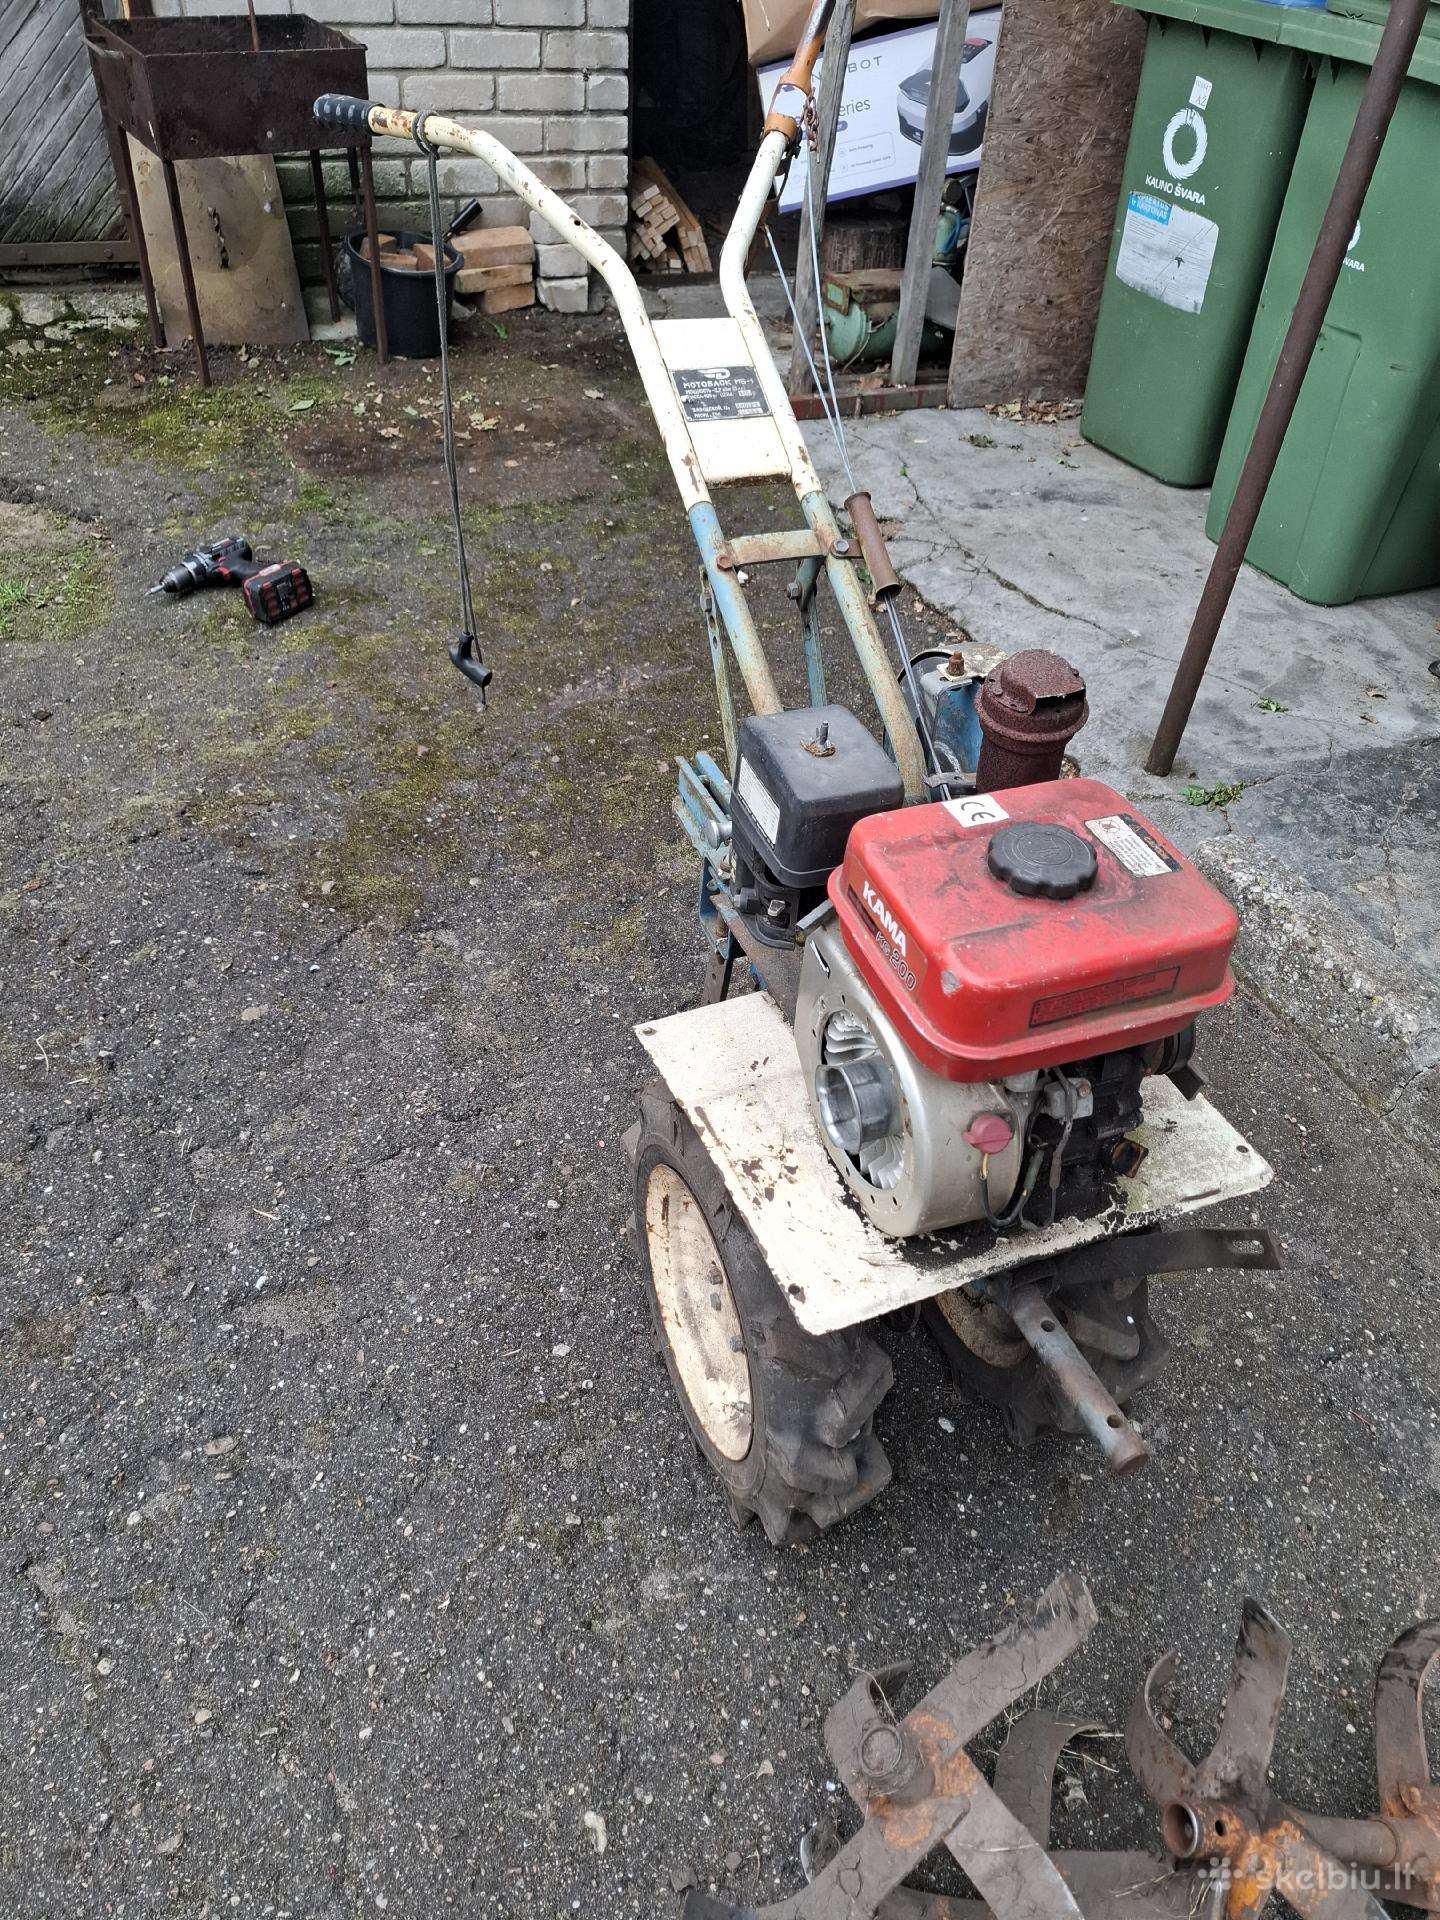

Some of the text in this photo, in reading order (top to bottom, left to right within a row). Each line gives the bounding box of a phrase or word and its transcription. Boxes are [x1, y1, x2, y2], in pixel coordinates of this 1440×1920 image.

[839, 99, 871, 117] eries
[1145, 174, 1206, 206] KAUNO ŠVARA
[683, 379, 732, 389] МОТОБЛОК
[863, 880, 906, 958] KAMA
